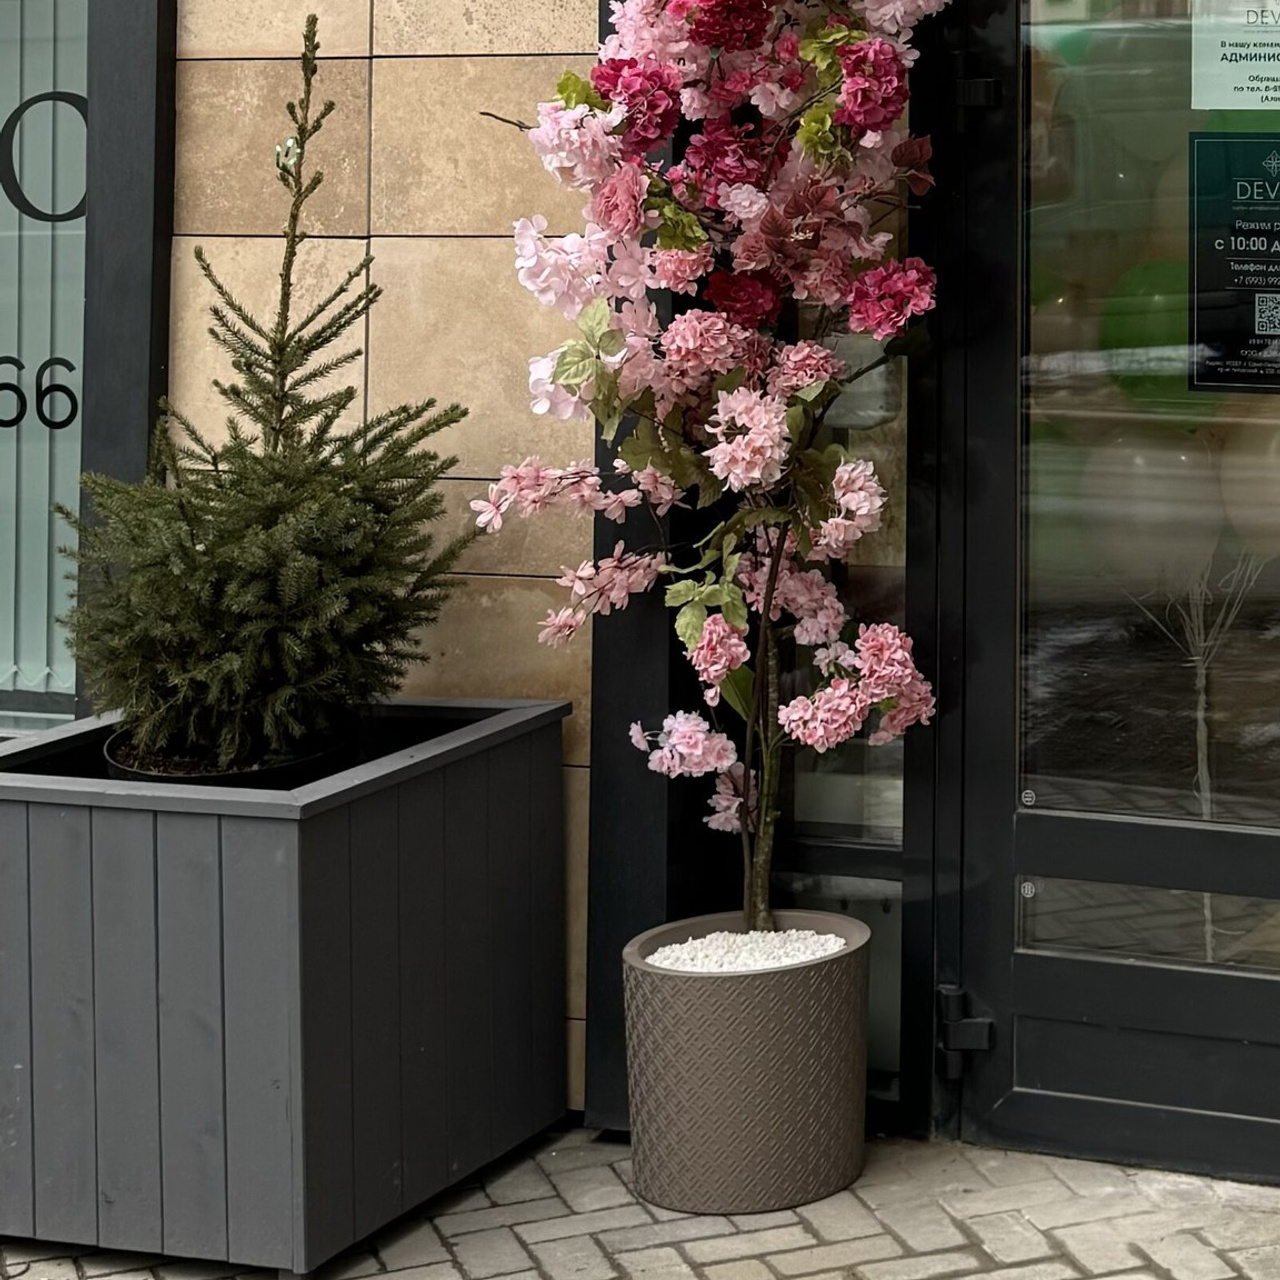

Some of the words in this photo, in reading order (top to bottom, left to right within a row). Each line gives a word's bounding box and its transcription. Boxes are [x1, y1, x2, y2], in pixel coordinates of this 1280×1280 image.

[1235, 220, 1271, 230] Режим
[1214, 239, 1225, 250] с
[1230, 236, 1267, 251] 10:00
[1230, 261, 1266, 272] Телефон
